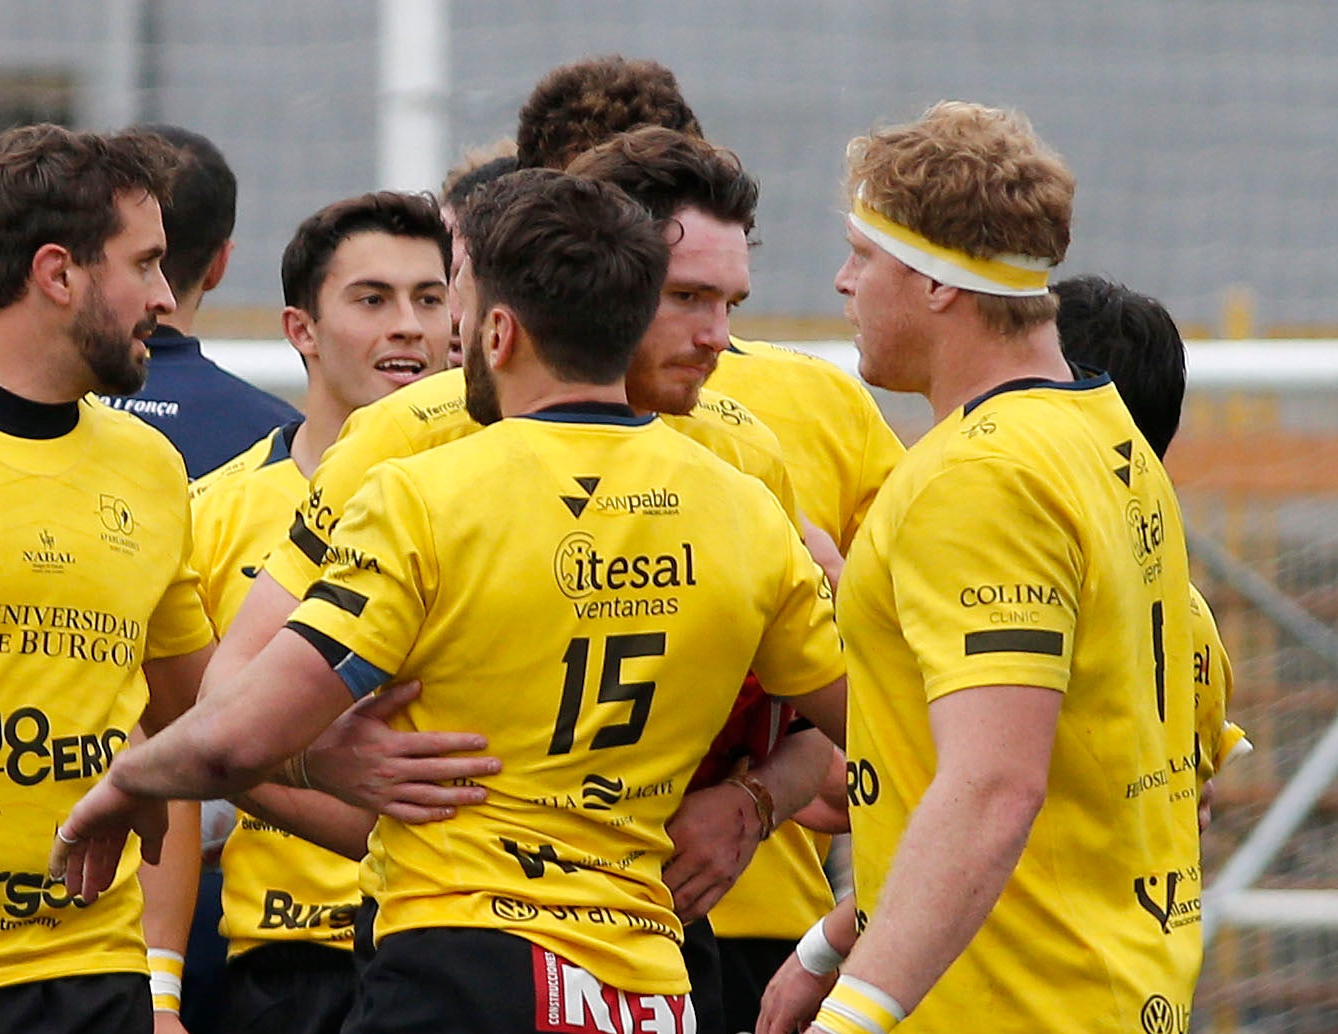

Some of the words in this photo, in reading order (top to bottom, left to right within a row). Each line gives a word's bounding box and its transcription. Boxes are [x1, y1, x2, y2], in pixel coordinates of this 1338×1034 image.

[575, 542, 697, 590] itesal
[573, 596, 679, 620] ventanas
[960, 584, 1063, 608] COLINA
[990, 611, 1040, 624] CLINIC
[548, 632, 666, 755] 15
